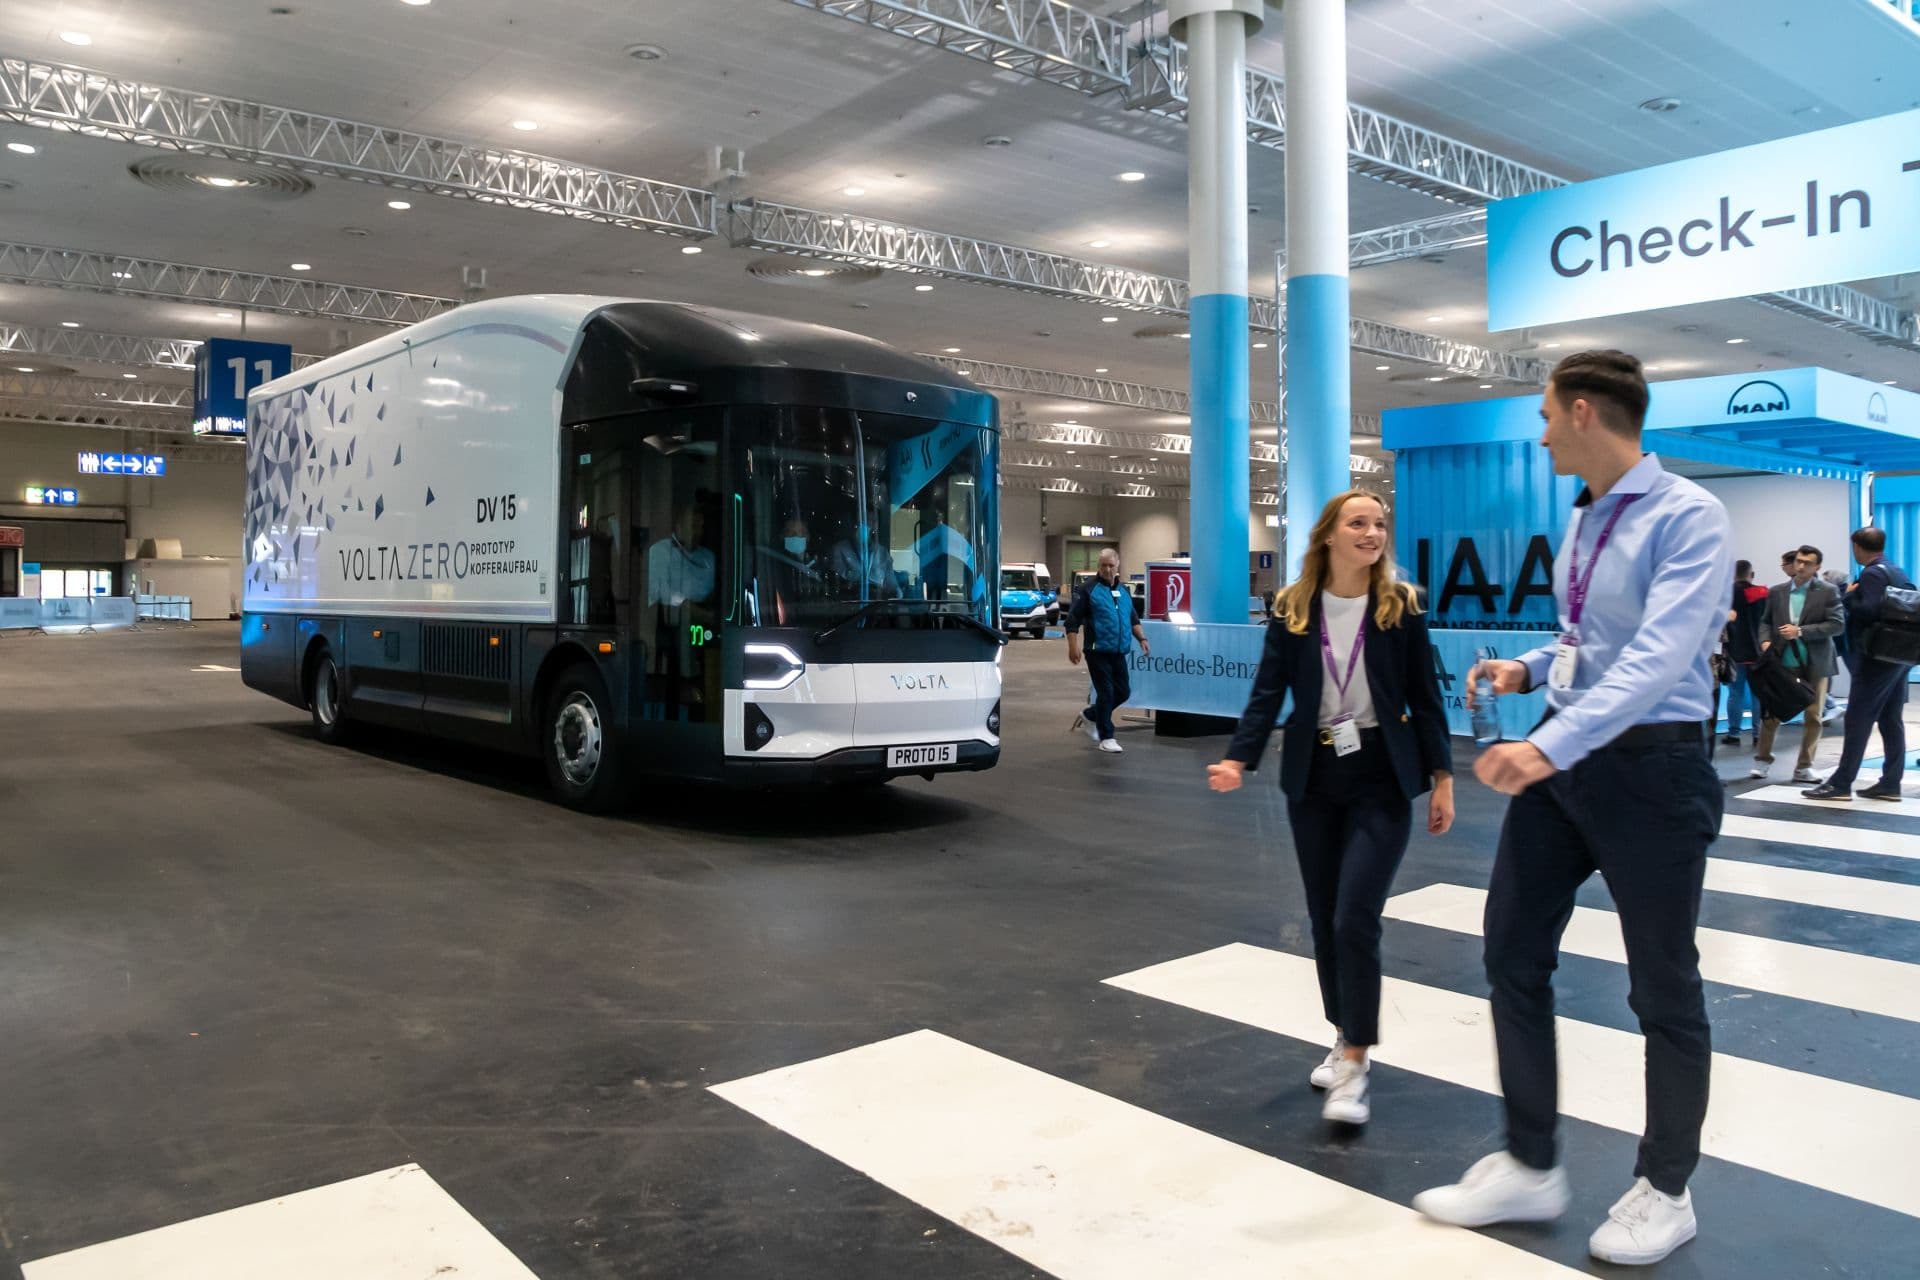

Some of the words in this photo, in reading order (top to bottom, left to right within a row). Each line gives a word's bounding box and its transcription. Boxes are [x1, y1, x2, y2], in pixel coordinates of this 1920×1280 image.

[1550, 180, 1871, 278] Check-In
[227, 357, 272, 399] 11
[1733, 401, 1783, 415] MAN
[470, 540, 515, 556] PROTOTYP
[470, 560, 538, 575] KOFFERAUFBAU
[1417, 535, 1555, 614] IAA
[890, 674, 949, 690] VOLTA
[895, 747, 935, 764] PROTO
[938, 746, 950, 761] 15
